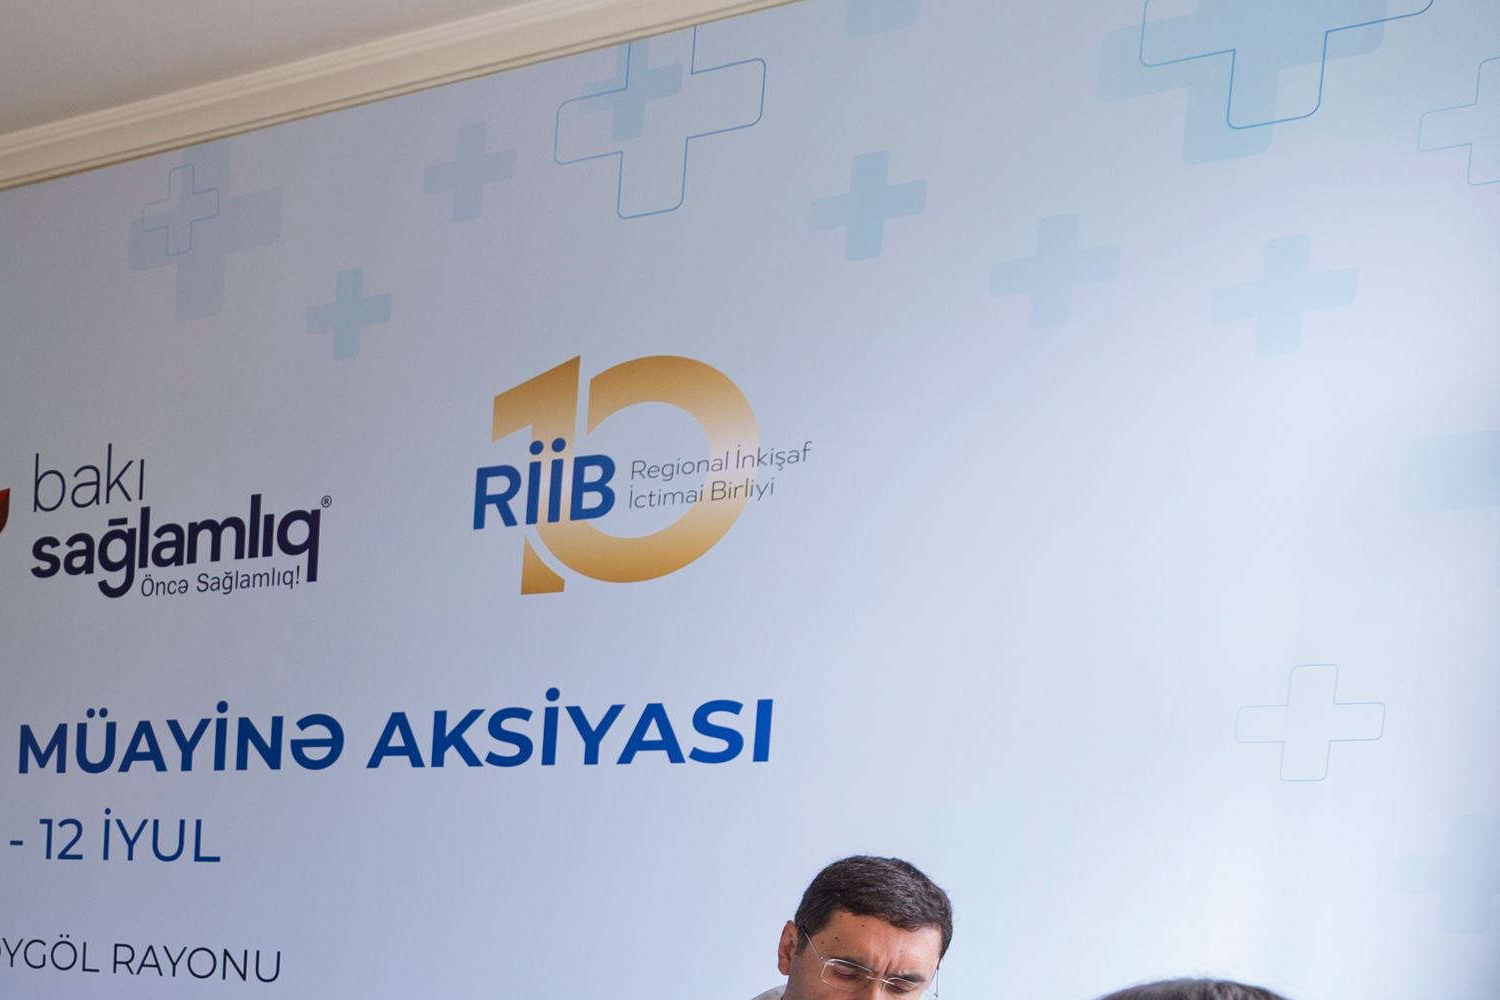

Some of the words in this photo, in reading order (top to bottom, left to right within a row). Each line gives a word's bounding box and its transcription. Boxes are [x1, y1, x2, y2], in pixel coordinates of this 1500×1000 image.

[33, 443, 145, 513] bakı
[630, 450, 729, 482] Regional
[735, 441, 813, 471] İnkişaf
[629, 481, 704, 510] İctimai
[711, 477, 775, 502] Birliyi
[141, 574, 189, 597] Öncə
[197, 565, 300, 595] Sağlamlıq!
[18, 700, 344, 774] MÜAYİNƏ
[366, 687, 775, 770] AKSİYASI
[39, 817, 83, 860] 12
[102, 807, 221, 862] İYUL
[113, 943, 281, 983] RAYONU
